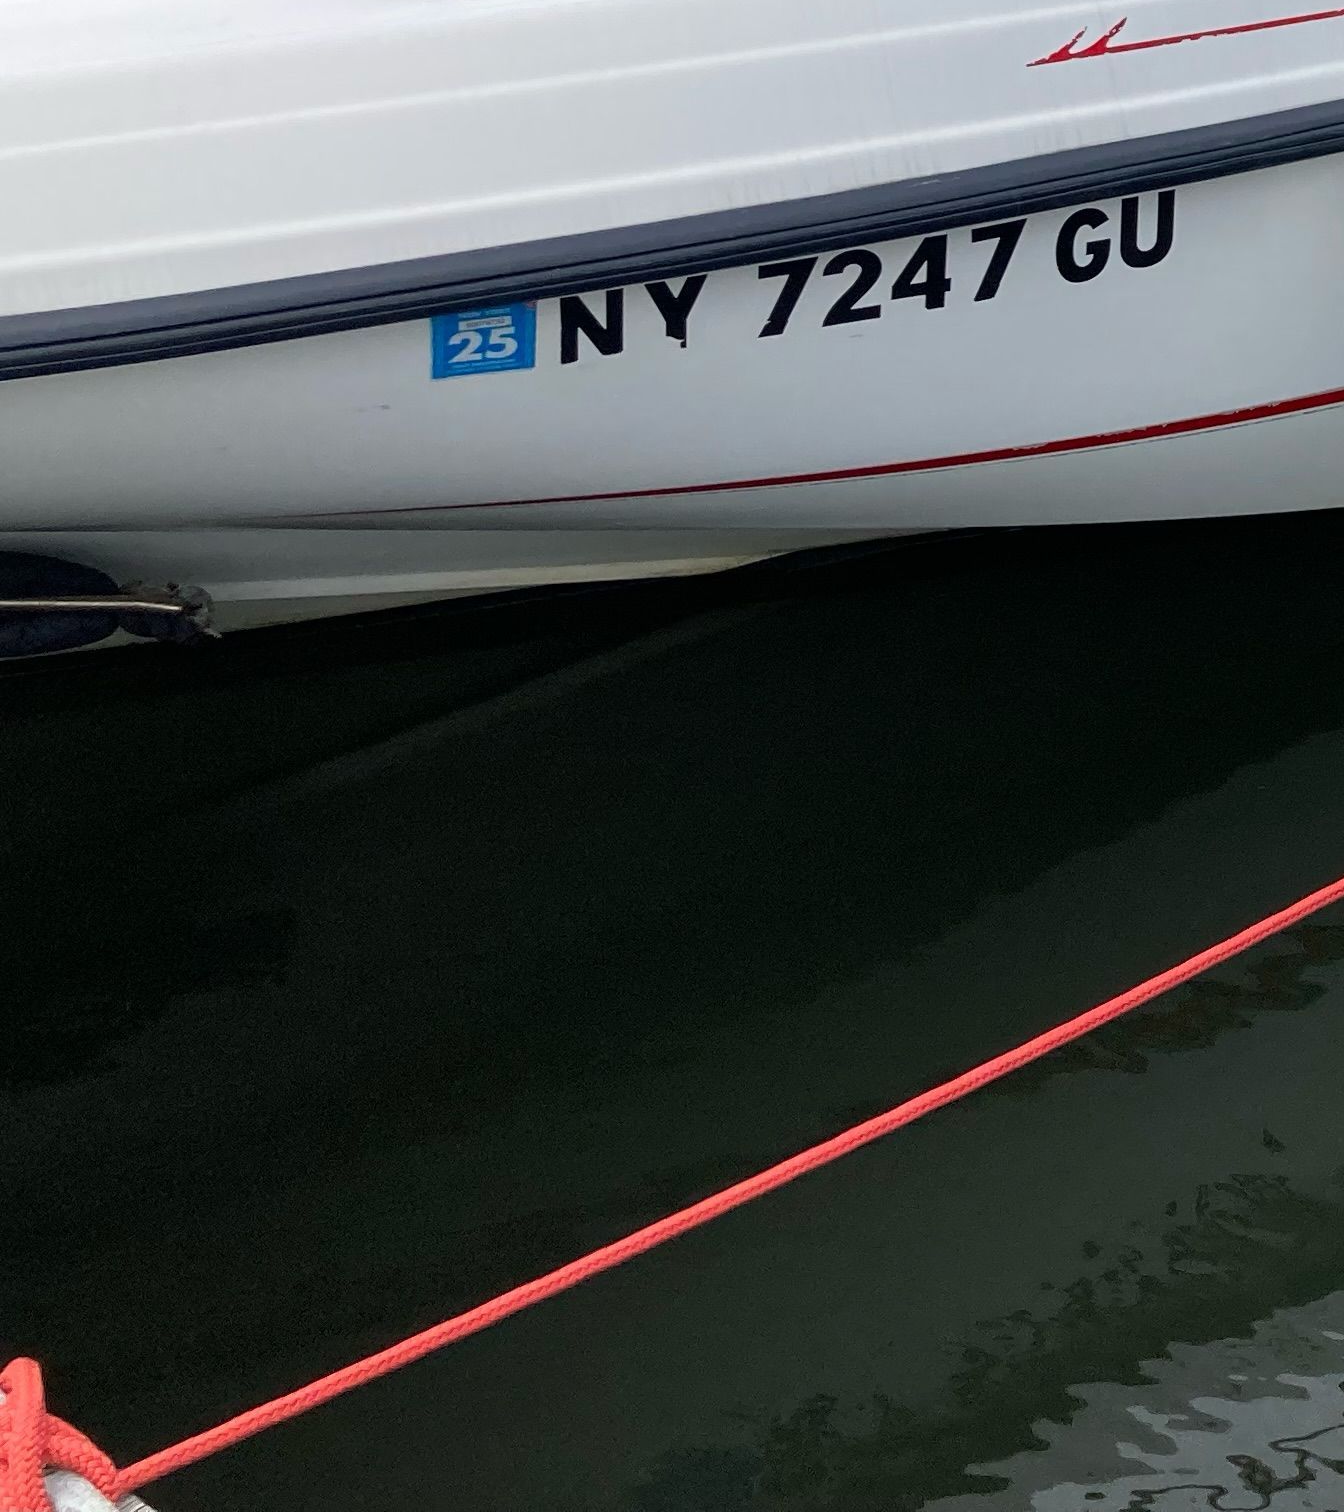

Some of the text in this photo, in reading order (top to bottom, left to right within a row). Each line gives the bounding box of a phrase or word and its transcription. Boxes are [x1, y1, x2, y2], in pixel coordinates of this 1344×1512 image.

[560, 189, 1176, 364] NY 7247 GU
[448, 326, 518, 363] 25
